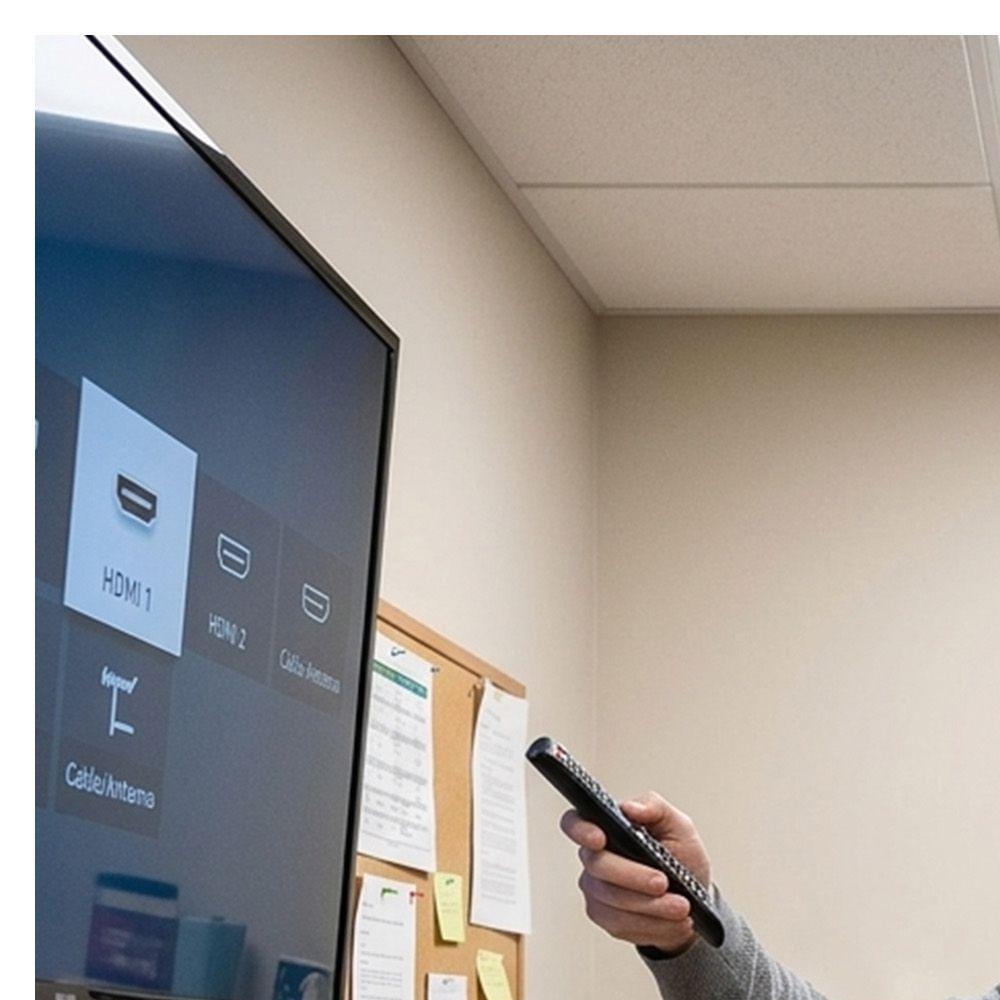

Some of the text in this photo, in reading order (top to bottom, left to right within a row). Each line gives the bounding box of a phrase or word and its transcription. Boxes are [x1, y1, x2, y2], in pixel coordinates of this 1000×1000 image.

[102, 565, 151, 611] HDMI 1
[238, 628, 246, 650] 2
